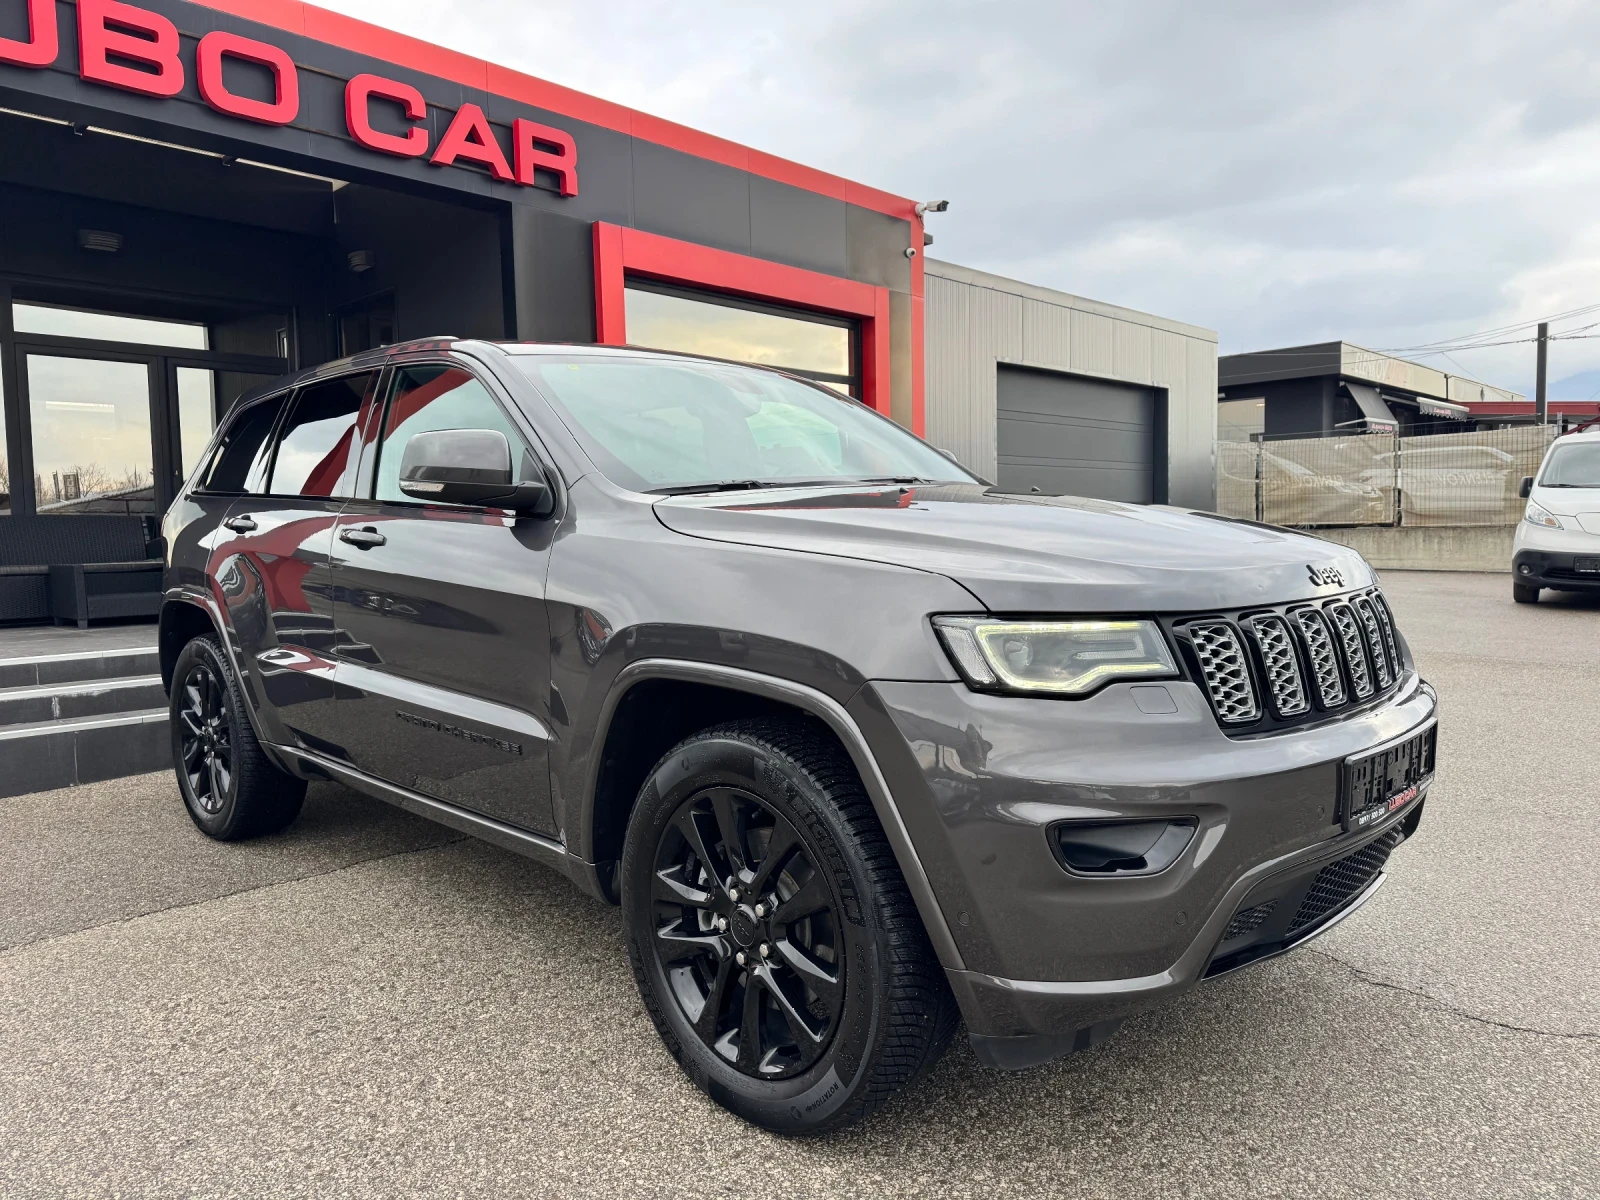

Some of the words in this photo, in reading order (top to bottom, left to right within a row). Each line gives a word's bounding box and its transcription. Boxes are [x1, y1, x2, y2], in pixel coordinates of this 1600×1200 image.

[345, 74, 578, 197] CAR
[1305, 564, 1345, 587] Jeep
[811, 1081, 839, 1111] ROTATION
